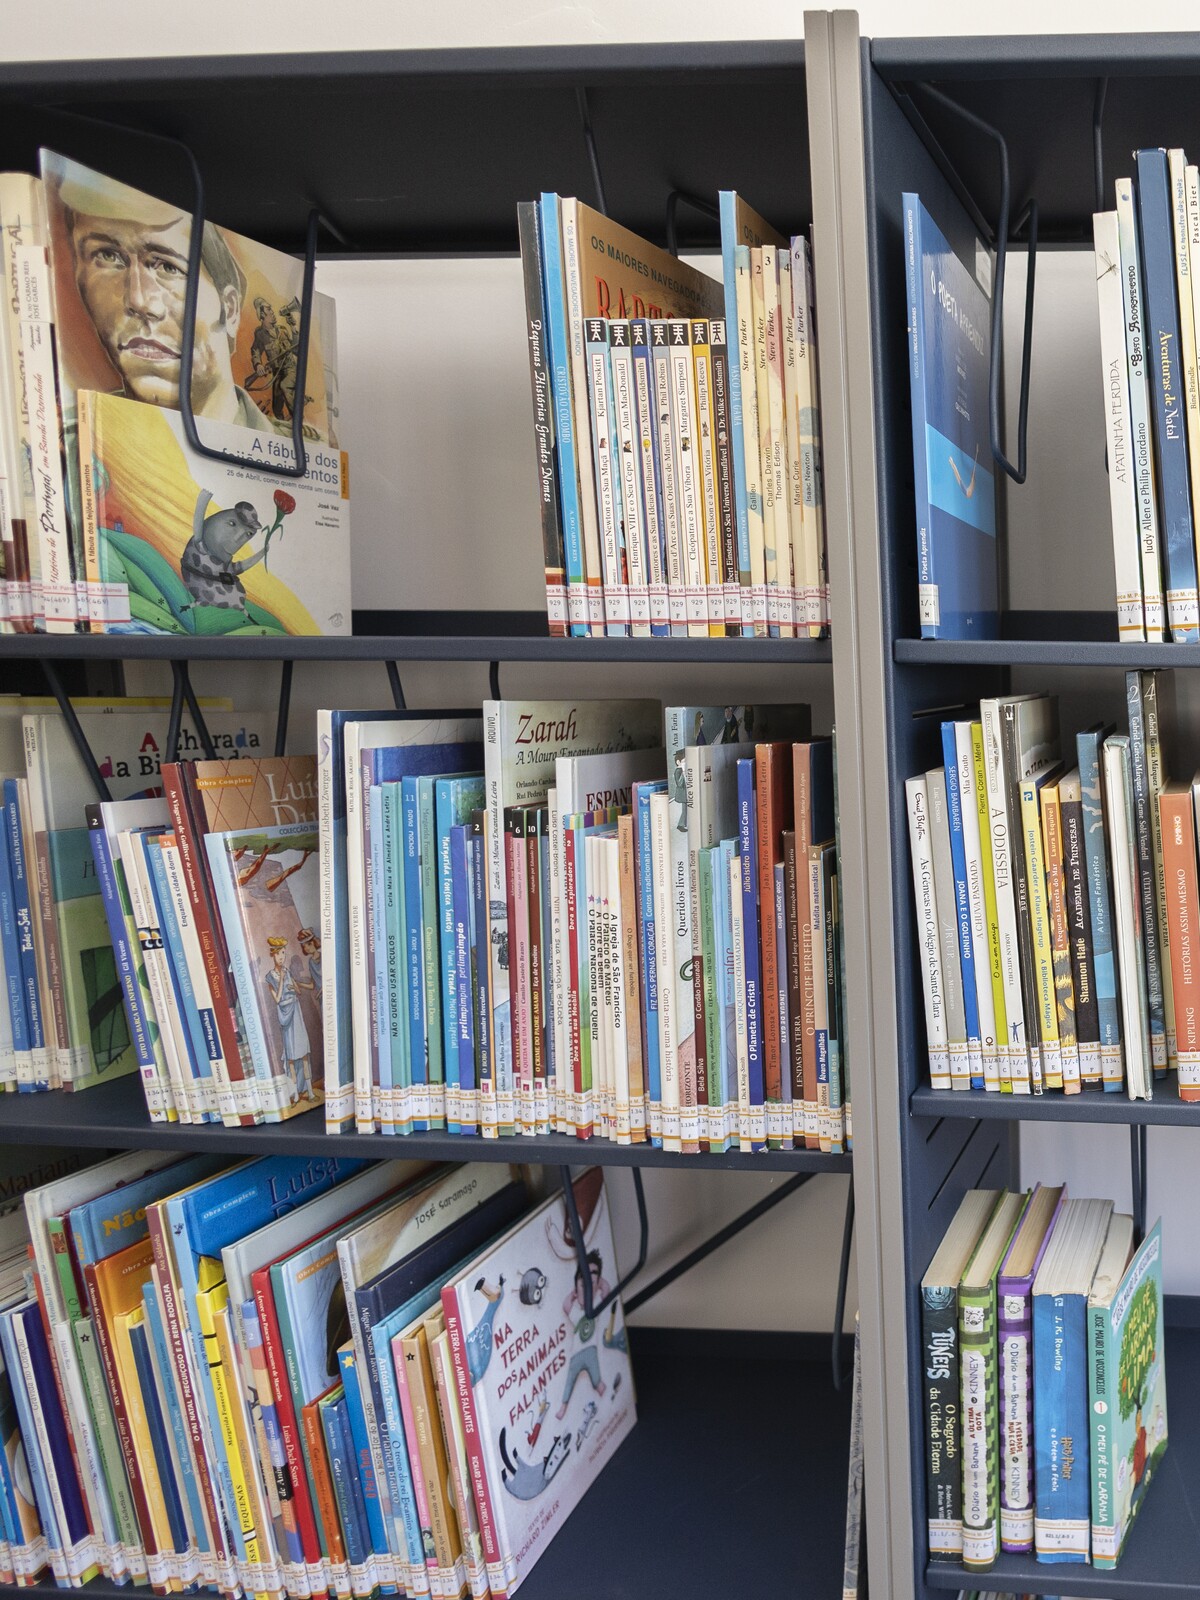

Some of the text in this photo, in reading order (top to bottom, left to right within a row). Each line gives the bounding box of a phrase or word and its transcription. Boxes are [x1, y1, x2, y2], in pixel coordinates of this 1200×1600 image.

[591, 236, 649, 277] OS MAIORES
[35, 373, 46, 421] Desenhada
[594, 358, 605, 416] Kjartan Poskitt
[618, 363, 630, 431] Alan MacDonald
[677, 362, 689, 433] Margaret Simpson
[1109, 359, 1122, 416] PERDIDA
[1158, 330, 1179, 439] Aventuras de Natal
[531, 319, 552, 502] Pequenas Histórias Grandes Nomes
[38, 424, 48, 453] Banda
[1137, 422, 1148, 466] Giordano
[43, 457, 50, 468] em
[83, 465, 91, 497] cinzentos
[601, 455, 610, 476] Maçã
[764, 447, 774, 507] Charles Darwin
[1138, 469, 1151, 496] Philip
[37, 469, 59, 533] Portugal
[86, 498, 94, 520] feijões
[774, 471, 783, 501] Thomas
[604, 507, 612, 536] Newton
[920, 528, 928, 555] Aprendiz
[1142, 507, 1153, 531] Allen
[606, 538, 614, 558] Isaac
[1143, 533, 1155, 554] Judy
[487, 716, 496, 743] ARQUIVO
[515, 708, 579, 744] Zarah
[685, 768, 694, 789] Vieira
[321, 769, 331, 940] Hans Christian Andersen Lisbeth Zwerger
[1067, 818, 1080, 866] PRINCESAS
[675, 860, 688, 937] Queridos livros
[1072, 883, 1084, 929] ACADEMIA
[1177, 869, 1192, 984] HISTÓRIAS ASSIM MESMO
[1076, 938, 1090, 1003] Shannon Hale
[415, 1179, 478, 1229] JOSÉ Saramago
[493, 1322, 514, 1350] NA
[501, 1324, 540, 1368] TERRA
[927, 1327, 955, 1380] TÚNEIS
[1054, 1338, 1062, 1371] Rowling
[497, 1322, 567, 1399] DOS ANIMAIS
[969, 1356, 978, 1394] KINNEY
[508, 1350, 567, 1426] FALANTES
[930, 1388, 940, 1474] da Cidade Eterna
[943, 1405, 956, 1458] O Segredo
[1097, 1424, 1107, 1523] O MEU PÉ DE LARANJA
